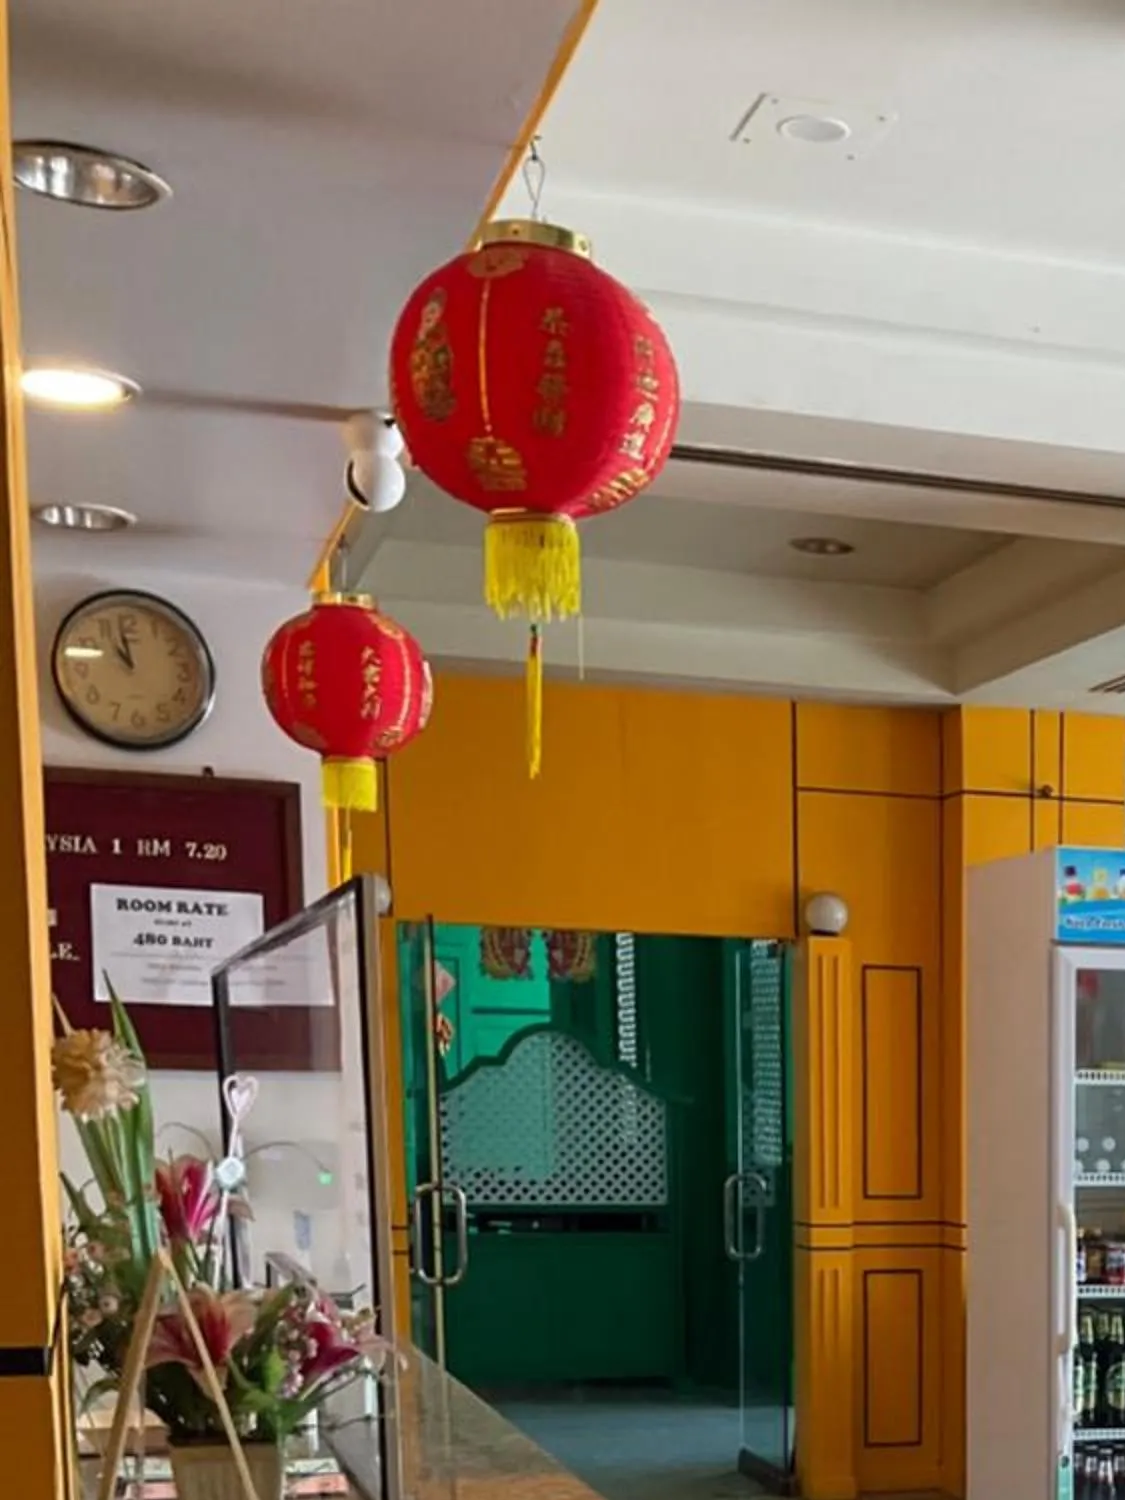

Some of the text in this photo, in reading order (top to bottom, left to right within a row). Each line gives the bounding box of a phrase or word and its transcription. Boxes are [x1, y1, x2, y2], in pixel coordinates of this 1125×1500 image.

[110, 702, 121, 721] 7
[131, 709, 146, 728] 6
[156, 703, 170, 722] 5
[112, 838, 121, 854] 1
[137, 838, 170, 857] RM
[185, 841, 228, 861] 7.20
[116, 898, 229, 916] ROOM RATE
[172, 936, 214, 948] BAHT
